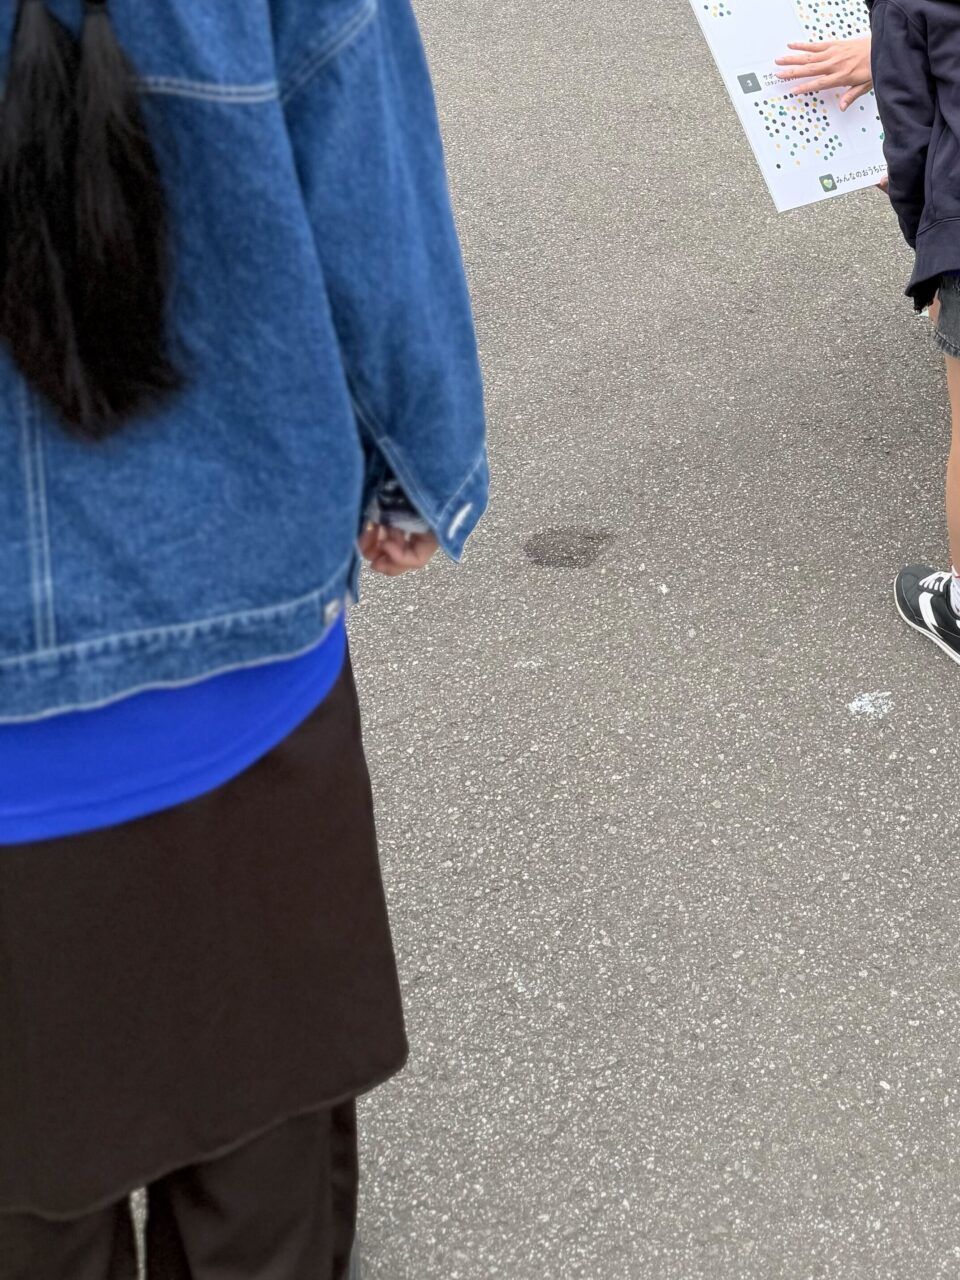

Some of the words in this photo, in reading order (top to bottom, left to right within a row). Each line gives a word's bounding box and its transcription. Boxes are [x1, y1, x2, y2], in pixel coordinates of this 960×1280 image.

[836, 164, 888, 183] みんなのおうちに
